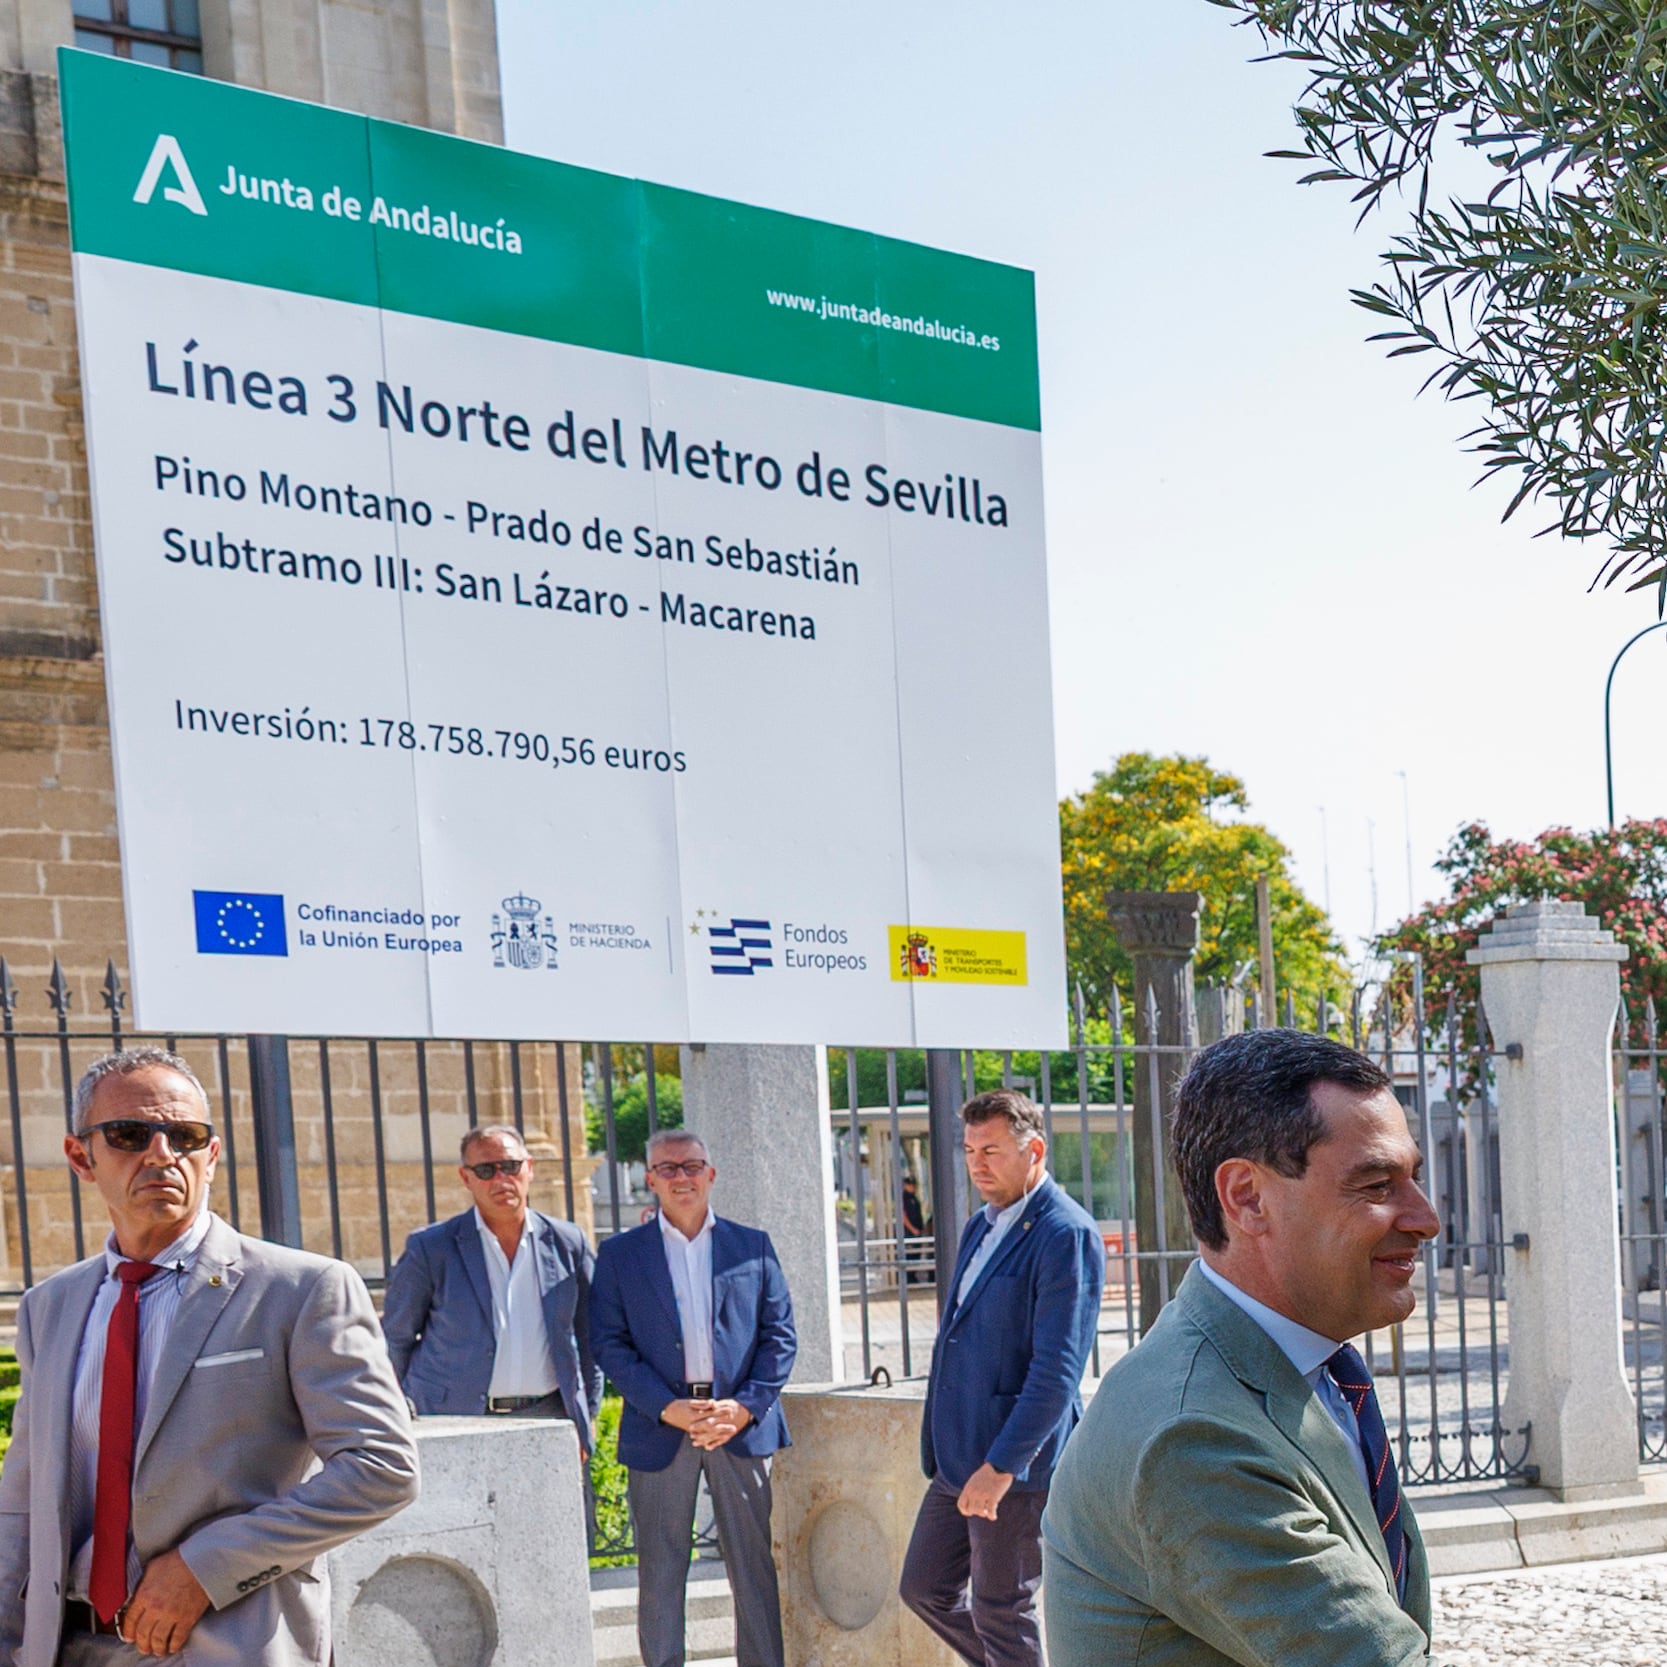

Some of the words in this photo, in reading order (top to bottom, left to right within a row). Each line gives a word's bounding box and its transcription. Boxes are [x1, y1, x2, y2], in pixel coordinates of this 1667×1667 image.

[219, 165, 314, 211] Junta
[321, 186, 362, 221] de
[369, 197, 522, 254] Andalucía
[766, 289, 1000, 351] www.juntadeandalucia.es
[145, 338, 308, 417] Línea
[326, 374, 358, 423] 3
[376, 380, 531, 452] Norte
[546, 409, 628, 469] del
[640, 426, 783, 491] Metro
[796, 450, 851, 502] de
[864, 463, 1009, 529] Sevilla
[154, 455, 248, 502] Pino
[259, 470, 433, 527] Montano
[466, 500, 573, 547] Prado
[581, 516, 624, 554] de
[633, 525, 696, 564] San
[705, 535, 860, 586] Sebastián
[163, 527, 364, 585] Subtramo
[374, 554, 424, 595] III:
[435, 563, 503, 604] San
[513, 570, 630, 619] Lázaro
[660, 591, 817, 641] Macarena
[175, 699, 348, 744] Inversión:
[360, 717, 597, 769] 178.758.790,56
[604, 746, 688, 773] euros
[297, 903, 425, 926] Cofinanciado
[431, 913, 462, 930] por
[569, 922, 636, 937] MINISTERIO
[783, 923, 849, 945] Fondos
[299, 929, 317, 947] la
[322, 930, 379, 949] Unión
[385, 933, 463, 955] Europea
[569, 935, 587, 948] DE
[589, 936, 652, 951] HACIENDA
[785, 948, 868, 974] Europeos
